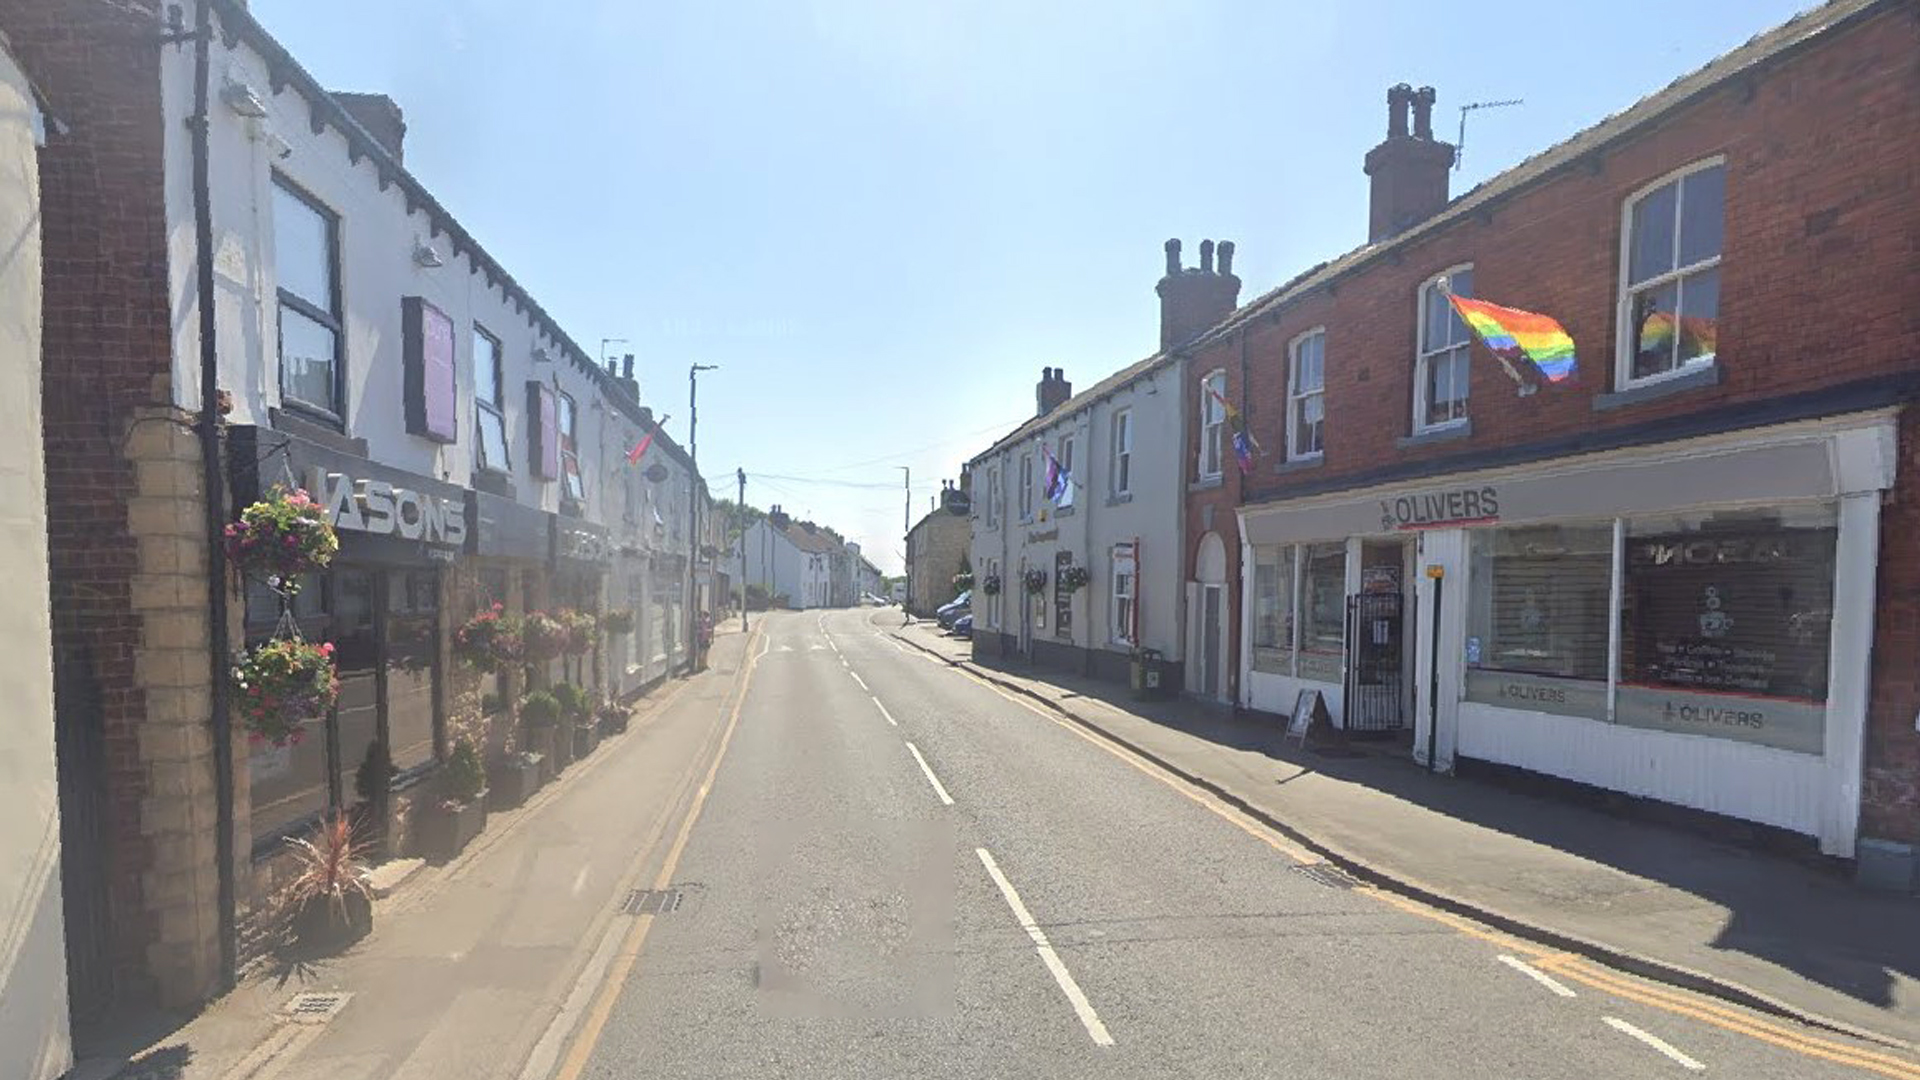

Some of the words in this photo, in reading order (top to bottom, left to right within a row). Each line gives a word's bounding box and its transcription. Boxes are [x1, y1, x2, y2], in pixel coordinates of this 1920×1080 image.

[1396, 486, 1499, 523] OLIVERS
[1508, 684, 1566, 703] OLIVERS
[1680, 704, 1764, 729] OLIVERS
